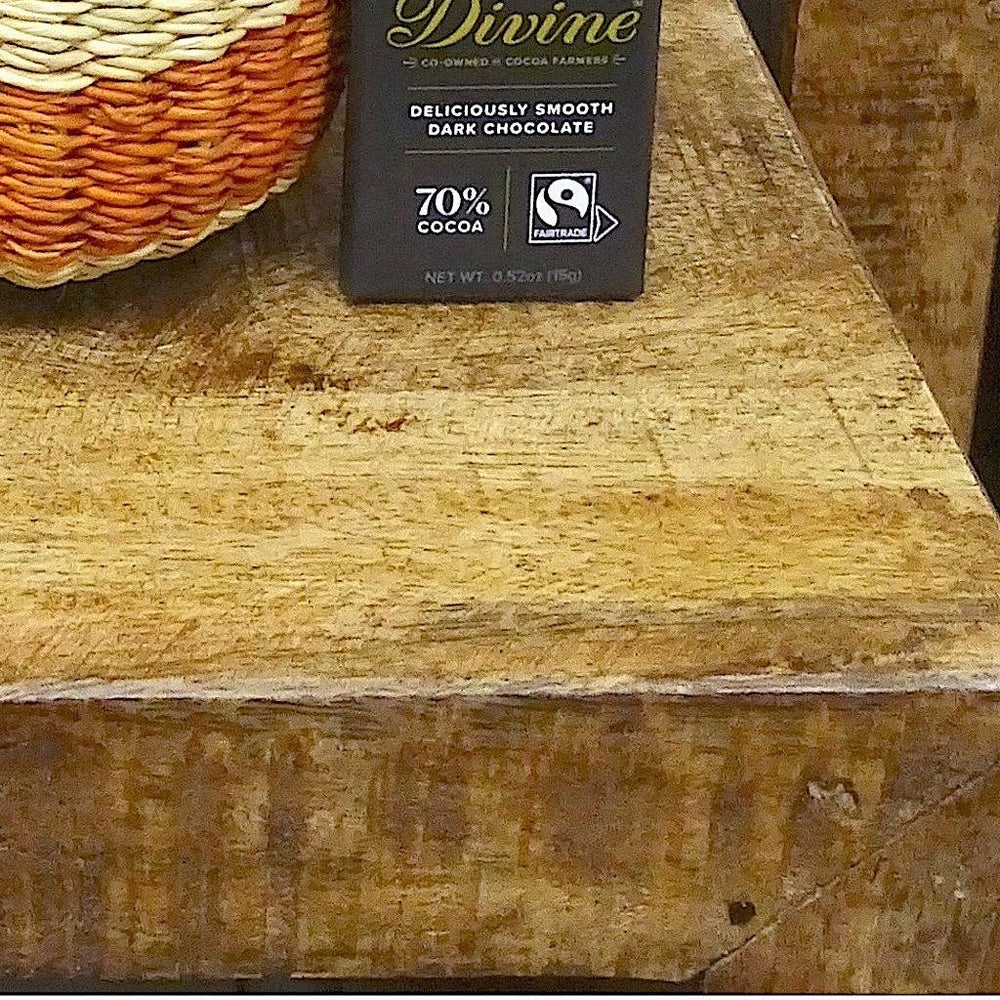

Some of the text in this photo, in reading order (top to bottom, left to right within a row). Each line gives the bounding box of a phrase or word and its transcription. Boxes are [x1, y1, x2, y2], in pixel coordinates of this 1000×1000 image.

[410, 102, 613, 118] DELICIOUSLY SMOOTH
[428, 121, 594, 136] DARK CHOCOLATE
[415, 186, 490, 217] 70%
[417, 219, 483, 234] COCOA
[534, 228, 588, 238] FAIRTRADE
[424, 271, 455, 284] NET
